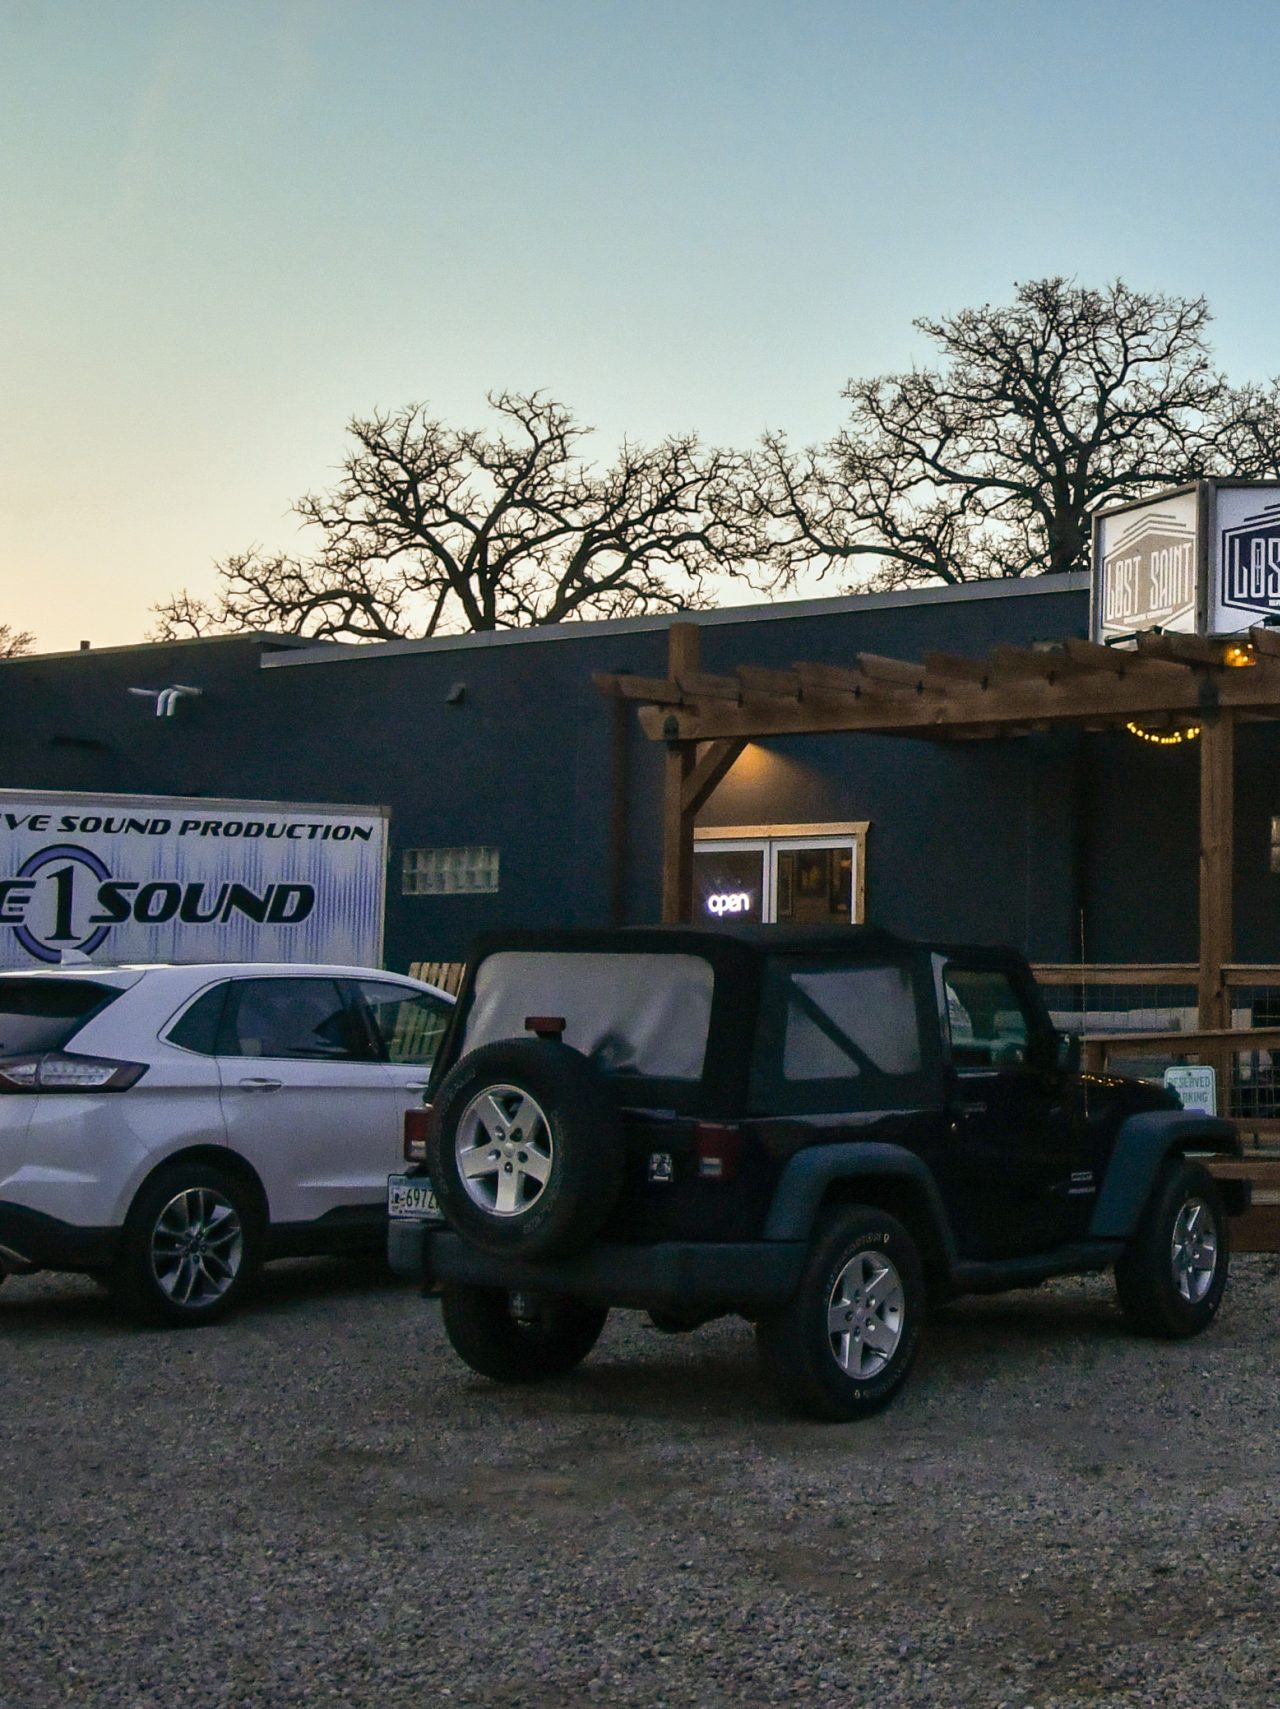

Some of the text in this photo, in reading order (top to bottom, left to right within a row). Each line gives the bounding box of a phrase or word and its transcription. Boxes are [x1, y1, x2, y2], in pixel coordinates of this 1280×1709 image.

[1106, 542, 1193, 621] LOST SAINT
[0, 813, 374, 841] VE SOUND PRODUCTION
[89, 881, 315, 924] SOUND
[708, 893, 750, 916] open
